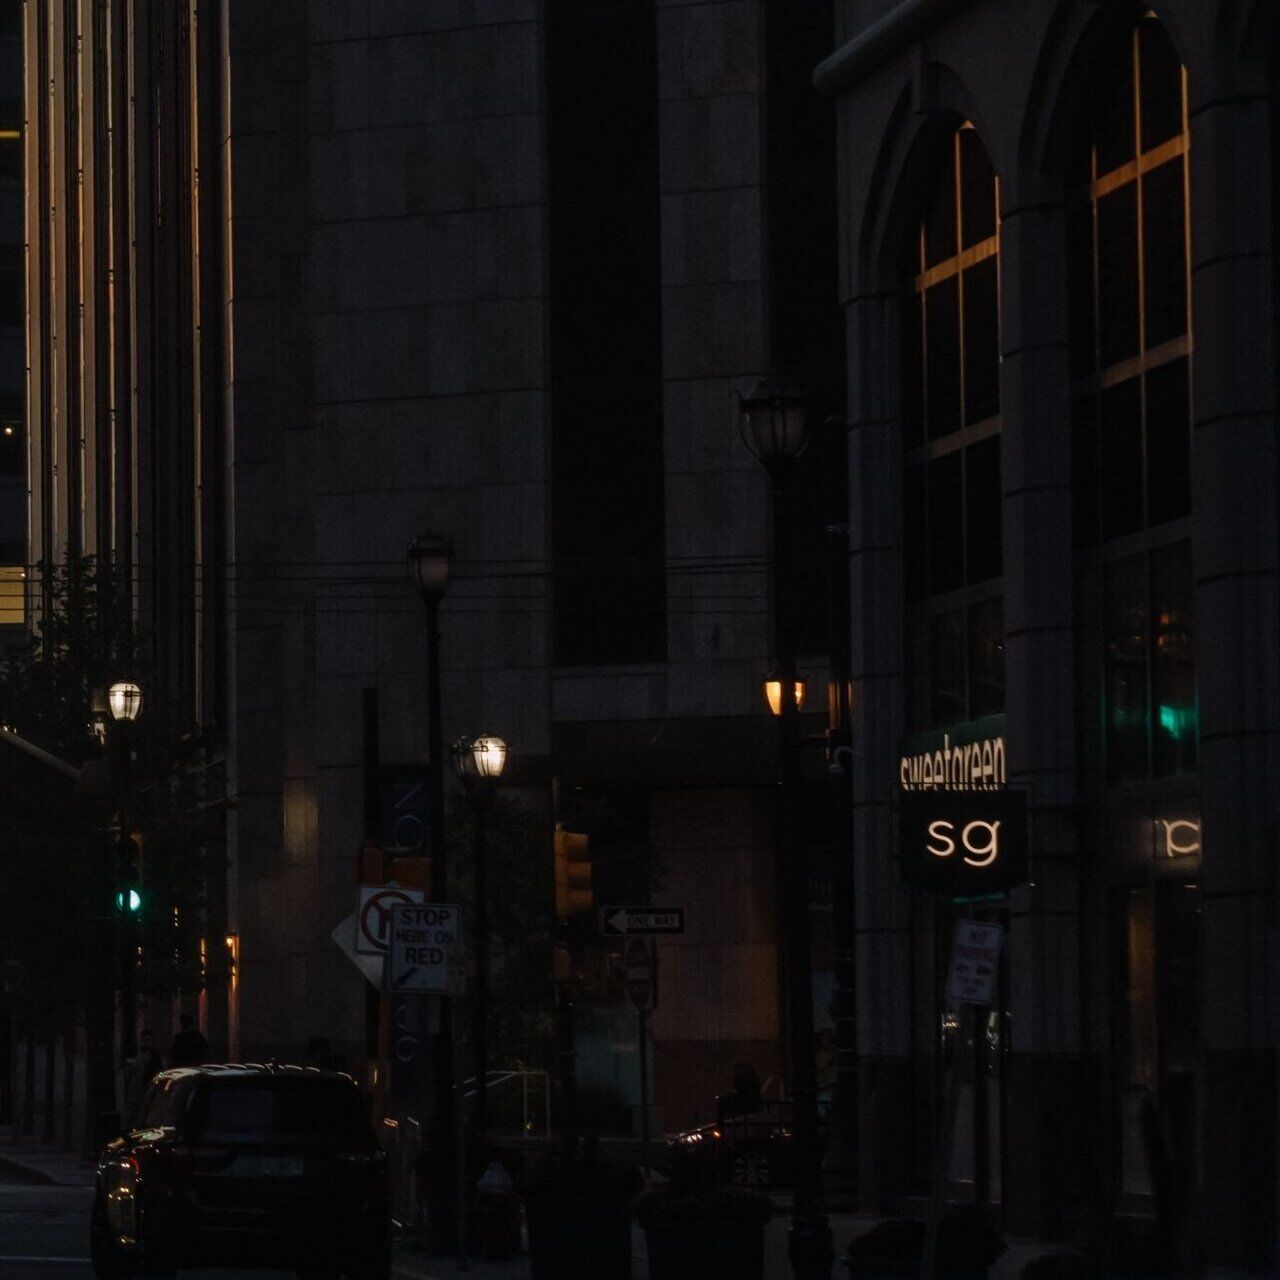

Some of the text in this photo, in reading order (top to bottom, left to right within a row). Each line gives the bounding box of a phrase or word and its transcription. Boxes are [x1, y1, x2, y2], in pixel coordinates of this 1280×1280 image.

[926, 820, 1000, 867] sg
[401, 908, 450, 926] STOP
[627, 914, 677, 927] ONE WAY
[396, 928, 454, 944] HERE ON
[405, 947, 444, 965] RED
